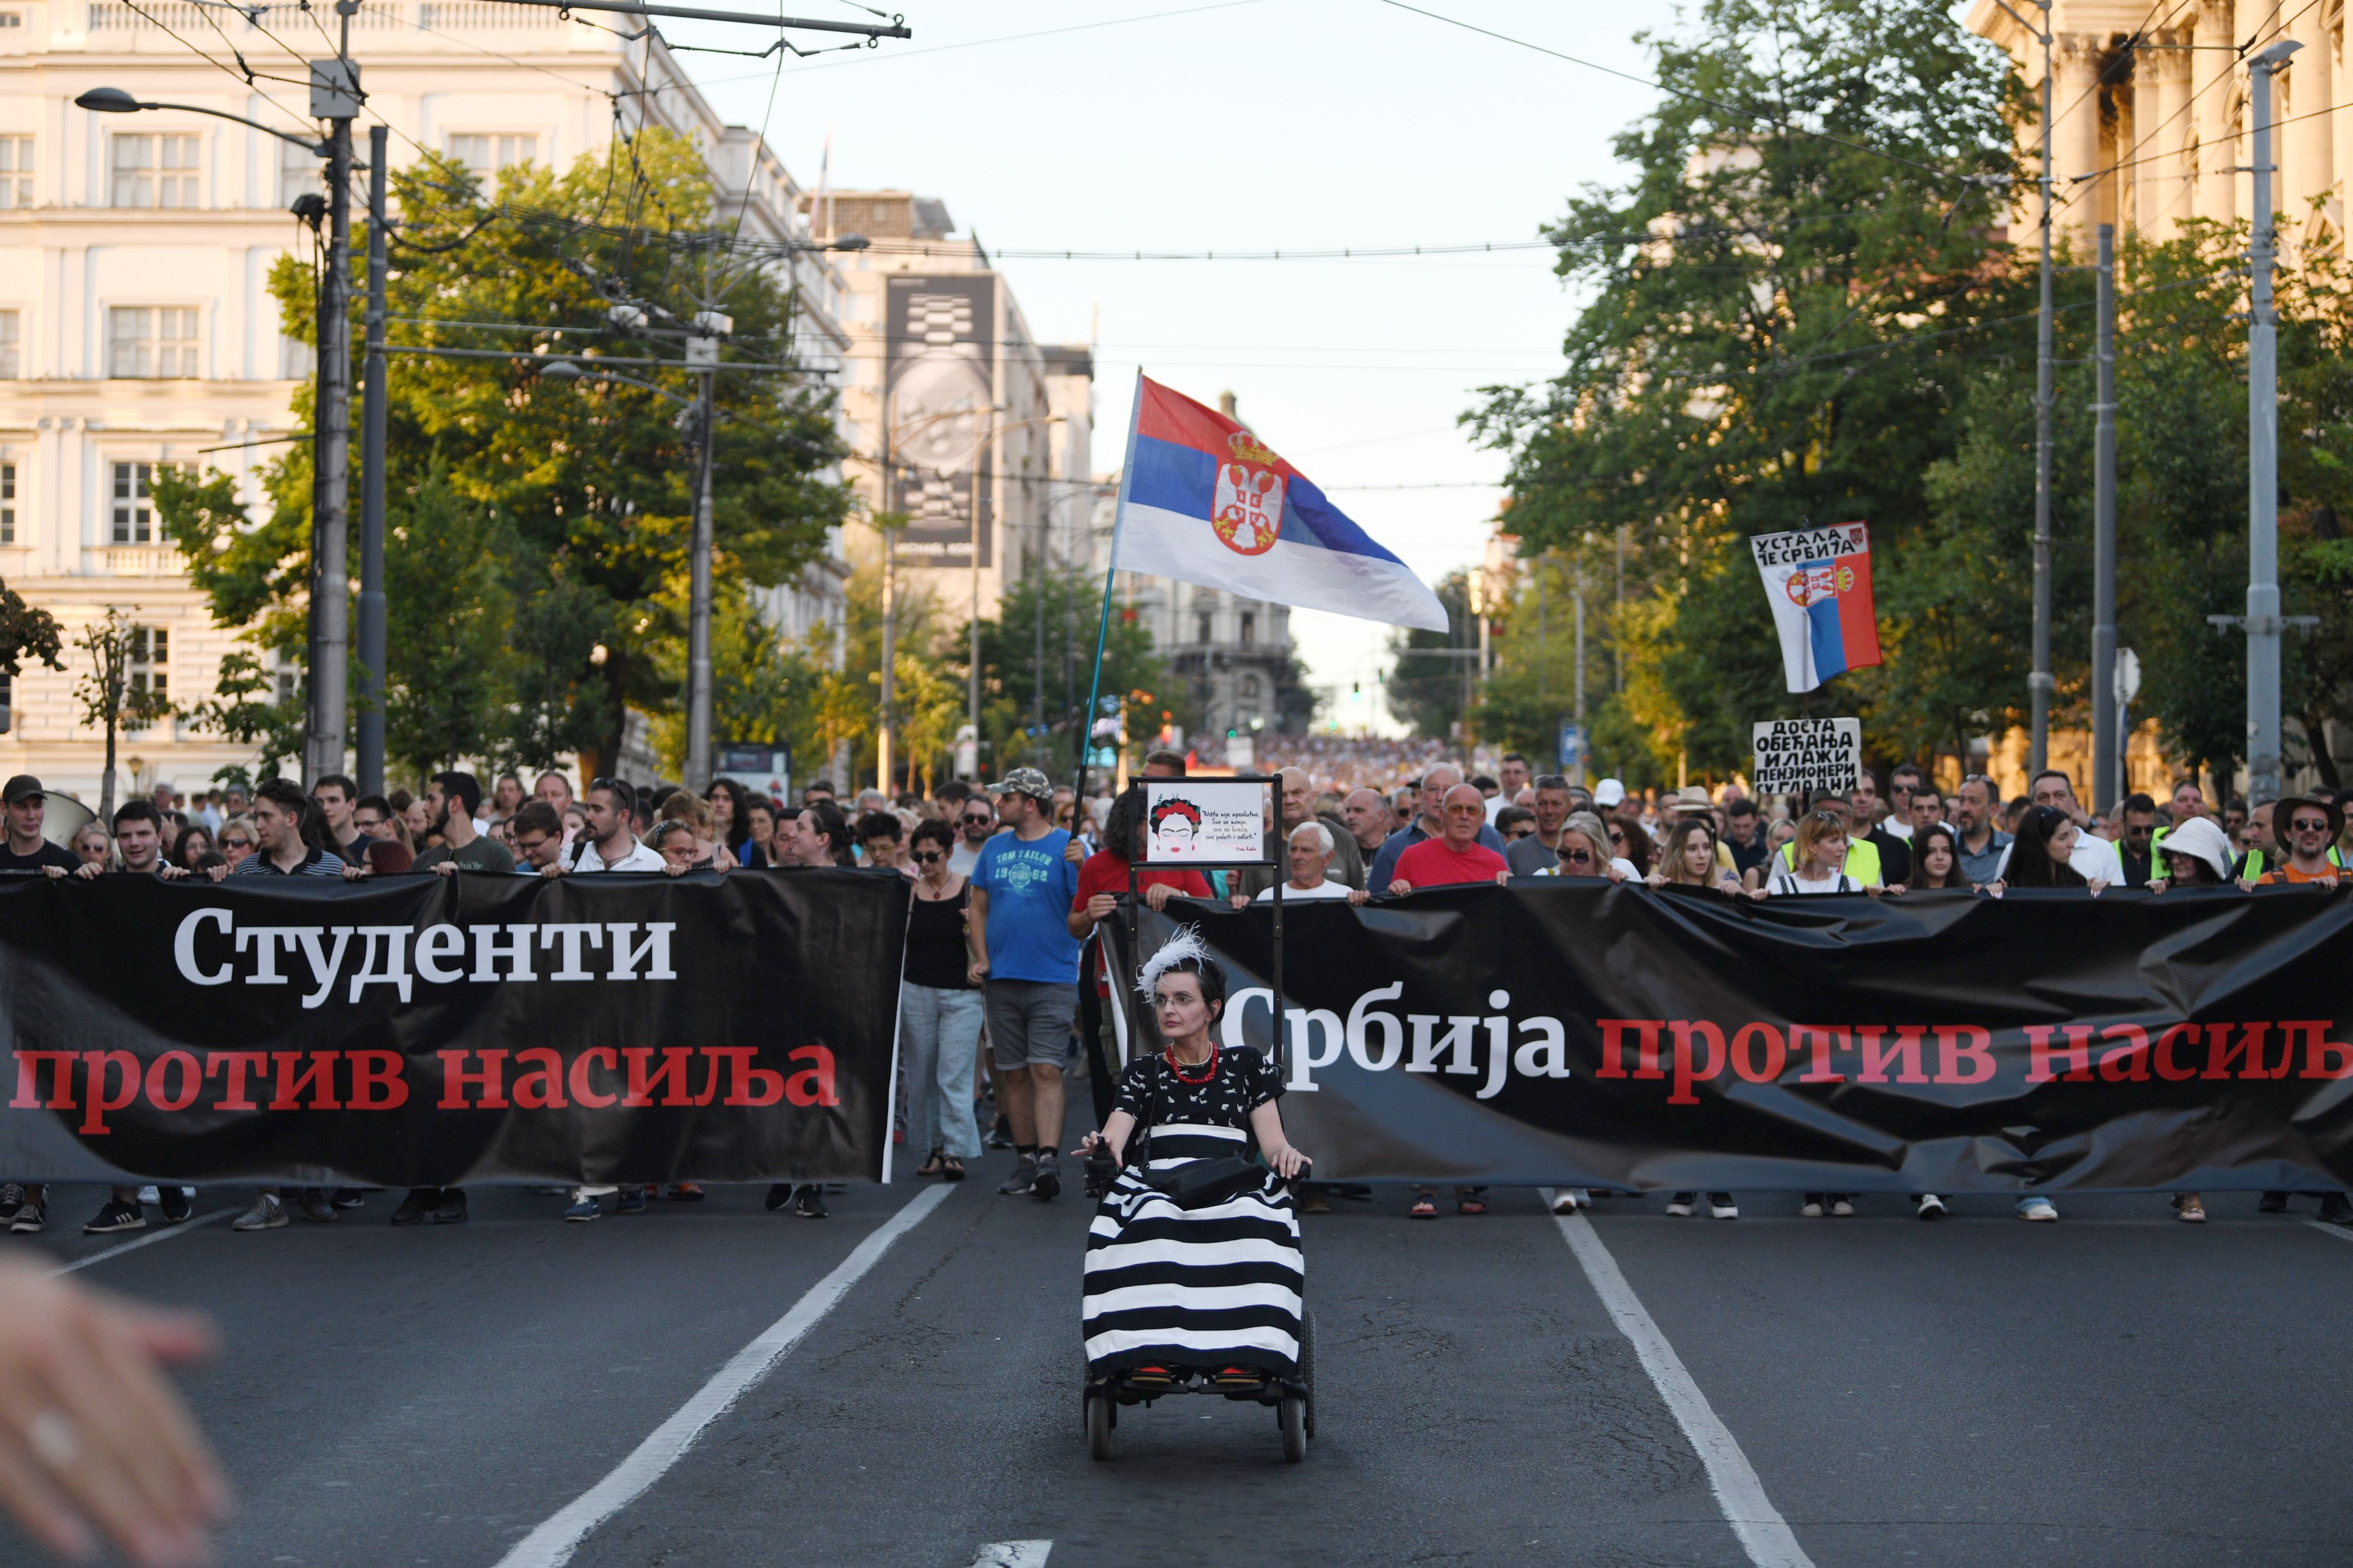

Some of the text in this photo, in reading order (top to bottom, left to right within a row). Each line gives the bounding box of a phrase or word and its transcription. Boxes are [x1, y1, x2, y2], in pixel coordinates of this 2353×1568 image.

[1756, 529, 1842, 552] УСТАЛА
[1781, 539, 1855, 562] СРБИЈА
[1771, 718, 1835, 736] ДОСТА
[1757, 731, 1853, 752] ОБЕЋАЊА
[1765, 749, 1849, 768] И ЛАЖИ
[1756, 762, 1855, 782] ПЕНЗИОНЕРИ
[1217, 833, 1231, 841] poleti
[996, 850, 1052, 866] TOM TAILOR
[995, 868, 1008, 879] 19
[175, 908, 676, 1009] Студенти
[1221, 981, 1569, 1099] Србија
[1595, 1019, 1997, 1105] против
[9, 1045, 839, 1135] против насиља
